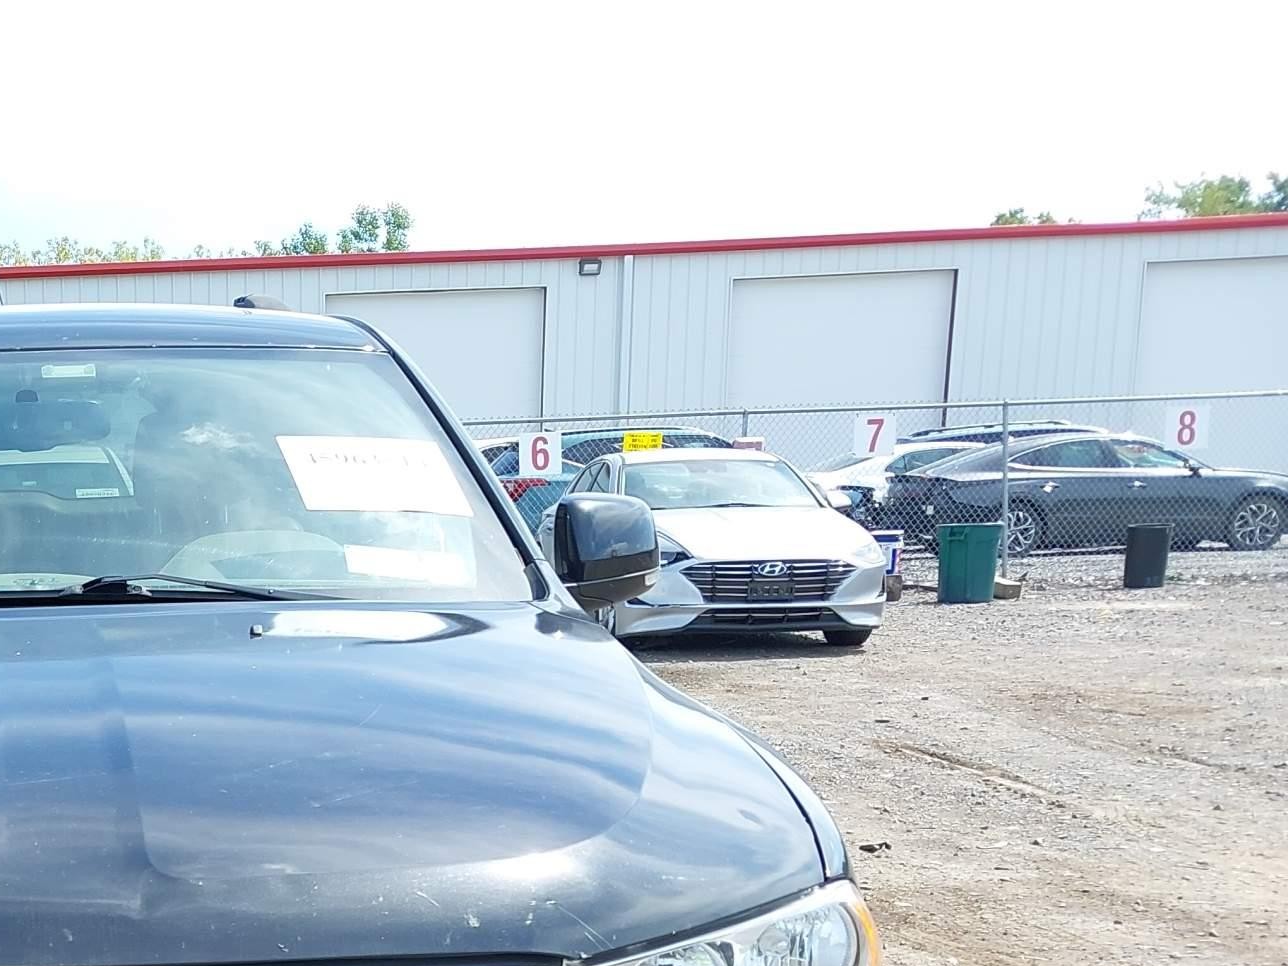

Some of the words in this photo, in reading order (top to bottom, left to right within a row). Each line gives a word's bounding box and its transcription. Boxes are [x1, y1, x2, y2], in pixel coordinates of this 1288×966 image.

[867, 419, 884, 452] 7
[1177, 410, 1196, 445] 8
[532, 436, 549, 470] 6
